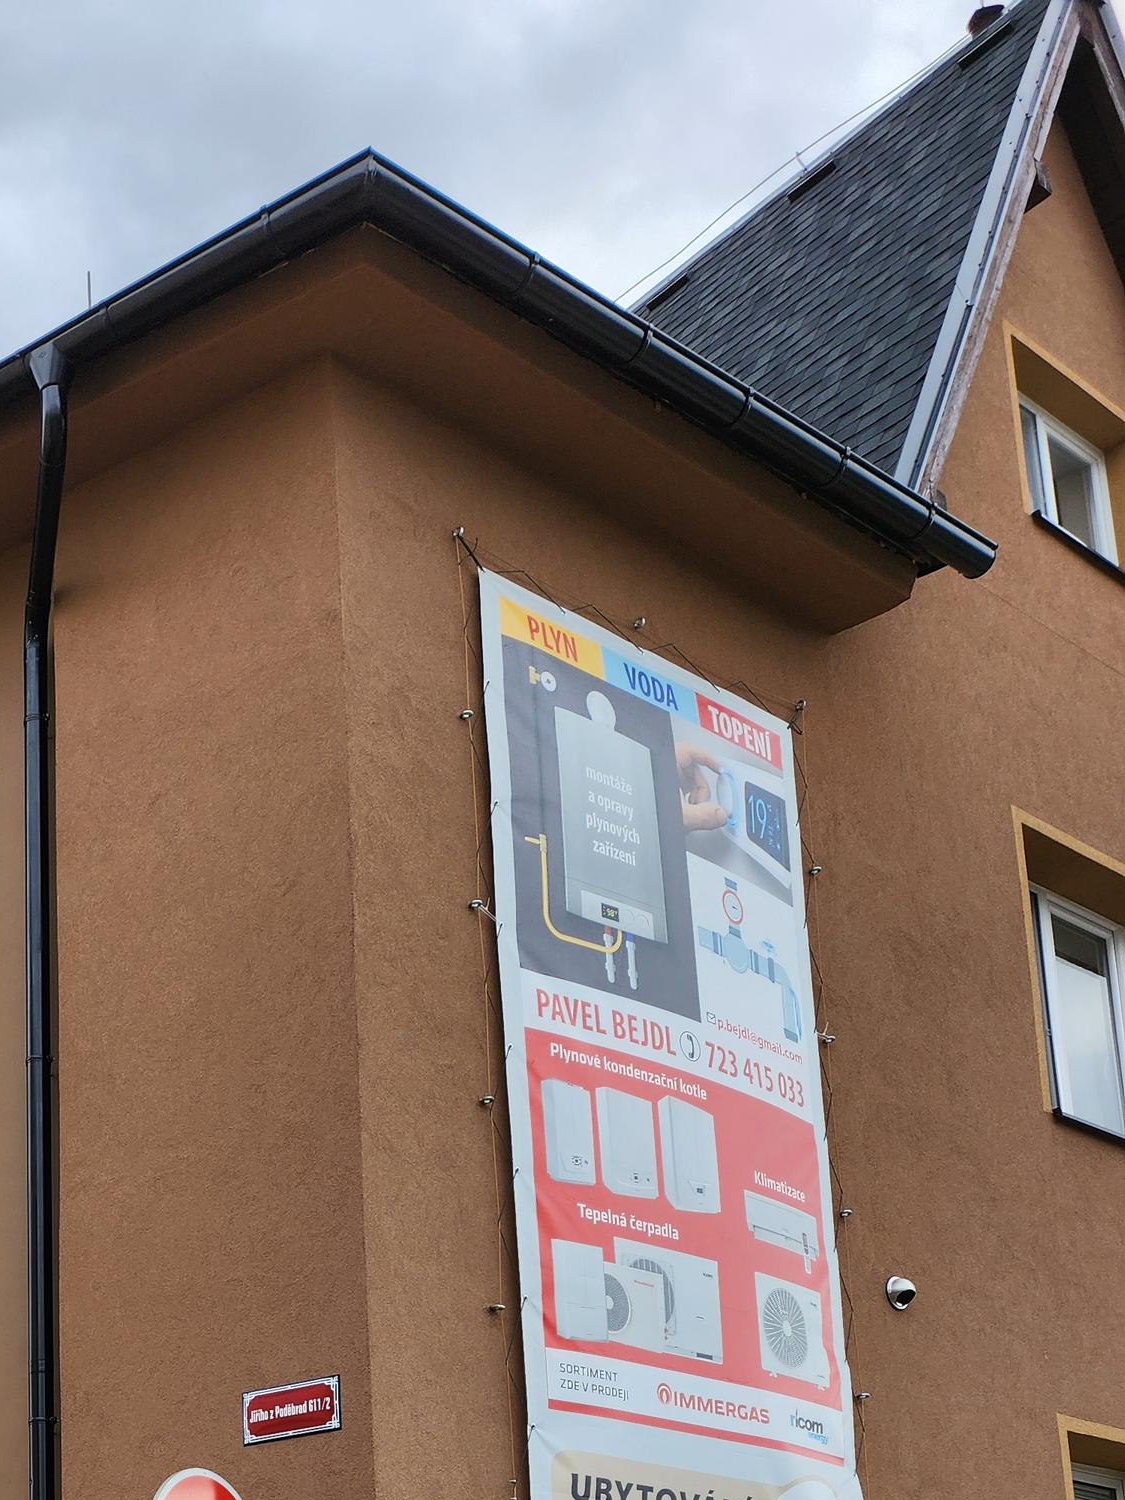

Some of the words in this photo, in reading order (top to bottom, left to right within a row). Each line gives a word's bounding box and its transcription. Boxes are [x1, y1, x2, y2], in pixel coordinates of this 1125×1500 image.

[527, 615, 579, 663] PLYN
[623, 662, 679, 711] VODA
[708, 704, 772, 762] TOPENÍ
[586, 765, 633, 795] montáže
[588, 790, 595, 801] a
[598, 794, 634, 821] opravy
[748, 794, 766, 839] 19
[586, 812, 640, 844] plynových
[593, 840, 636, 866] zařízení
[536, 988, 607, 1035] PAVEL
[611, 1009, 677, 1056] BEJDL
[717, 1018, 803, 1064] p.bejdl@gmail.com
[550, 1042, 601, 1068] Plynové
[603, 1056, 677, 1091] kondenzační
[680, 1078, 707, 1100] kotle
[705, 1041, 738, 1078] 723
[743, 1058, 773, 1092] 415
[778, 1072, 804, 1107] 033
[754, 1170, 806, 1202] Klimatizace
[577, 1202, 626, 1227] Tepelná
[630, 1215, 679, 1240] čerpadla
[559, 1362, 618, 1382] SORTIMENT
[560, 1378, 579, 1391] ZDE
[582, 1382, 589, 1392] V
[591, 1384, 629, 1401] PRODEJI
[275, 1401, 307, 1418] Poděbrad
[309, 1397, 330, 1412] 611/2
[674, 1391, 770, 1424] IMMERGAS
